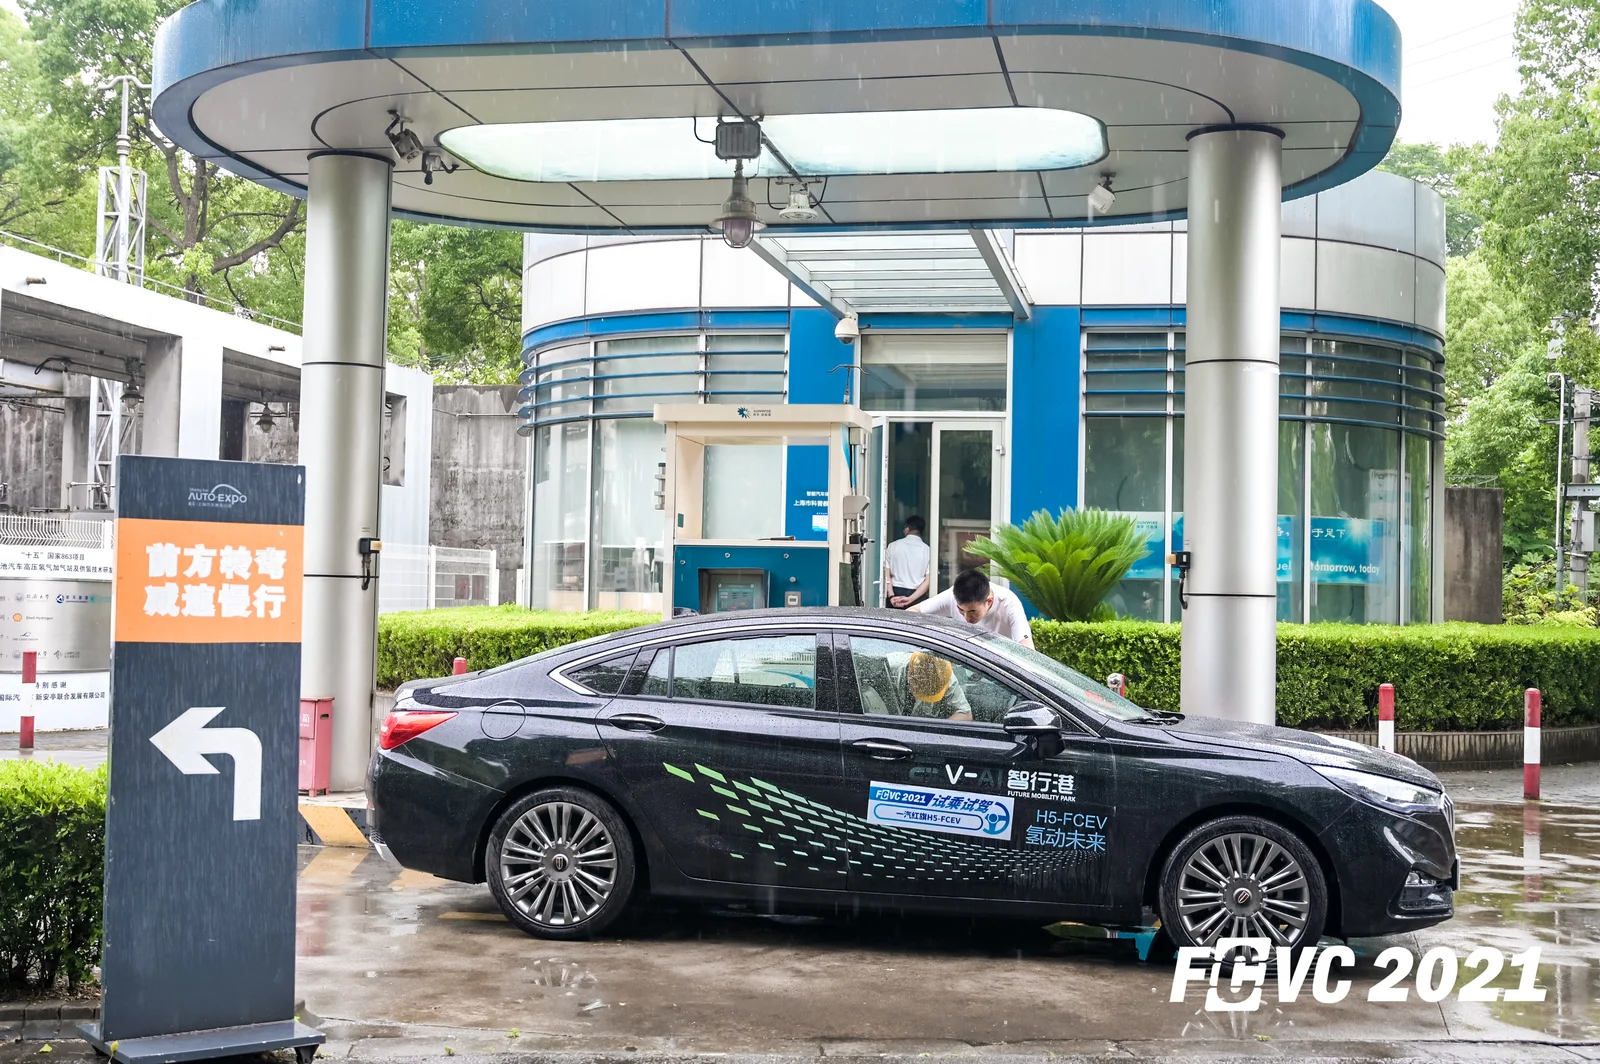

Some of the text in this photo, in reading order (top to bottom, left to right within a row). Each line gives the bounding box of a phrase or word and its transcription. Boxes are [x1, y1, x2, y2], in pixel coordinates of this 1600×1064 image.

[146, 542, 287, 580] 前方转弯
[1359, 563, 1380, 575] today
[143, 582, 286, 618] 减速慢行
[1007, 769, 1075, 795] 智行港
[901, 793, 926, 804] 2021
[932, 794, 993, 814] 试乘试驾
[1008, 790, 1030, 798] FUTURE
[1031, 793, 1059, 801] MOBILITY
[1036, 809, 1108, 830] H5-FCEV
[1025, 825, 1106, 852] 氢动未来
